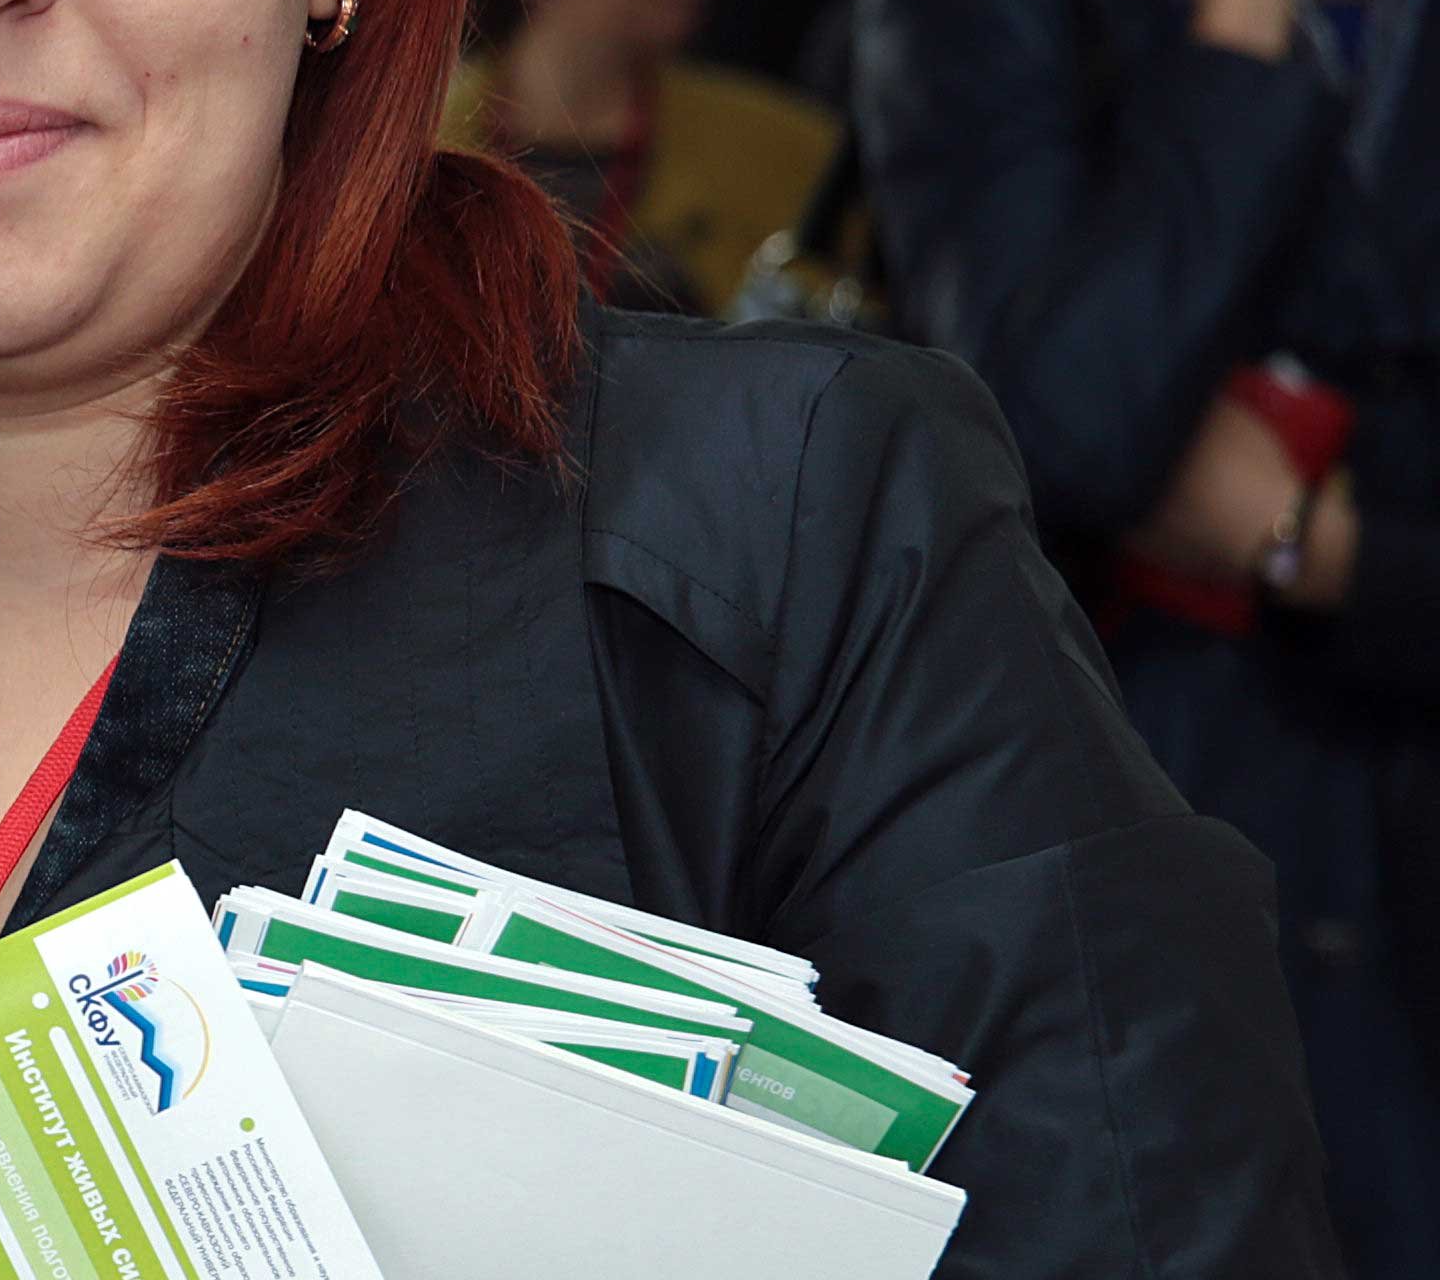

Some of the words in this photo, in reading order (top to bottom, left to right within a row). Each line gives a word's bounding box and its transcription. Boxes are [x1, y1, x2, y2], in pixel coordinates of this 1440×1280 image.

[68, 973, 121, 1046] СКФУ
[4, 1028, 76, 1148] Институт
[62, 1150, 122, 1245] живых
